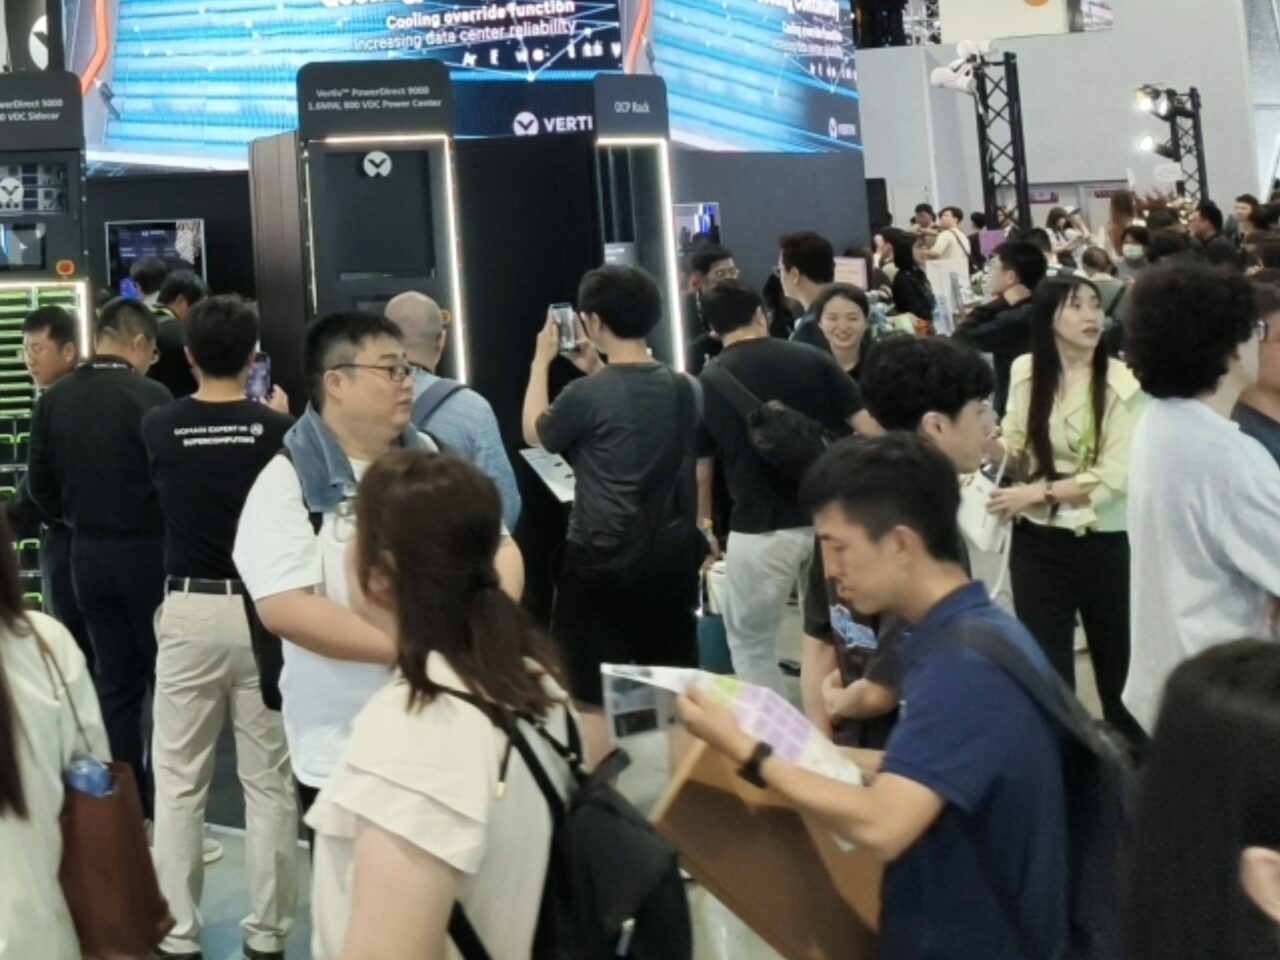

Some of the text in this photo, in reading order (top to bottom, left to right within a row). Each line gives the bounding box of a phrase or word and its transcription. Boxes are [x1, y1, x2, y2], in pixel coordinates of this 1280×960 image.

[385, 0, 576, 30] Cooling override function
[426, 29, 456, 45] data
[460, 24, 505, 42] center
[509, 17, 577, 39] reliability
